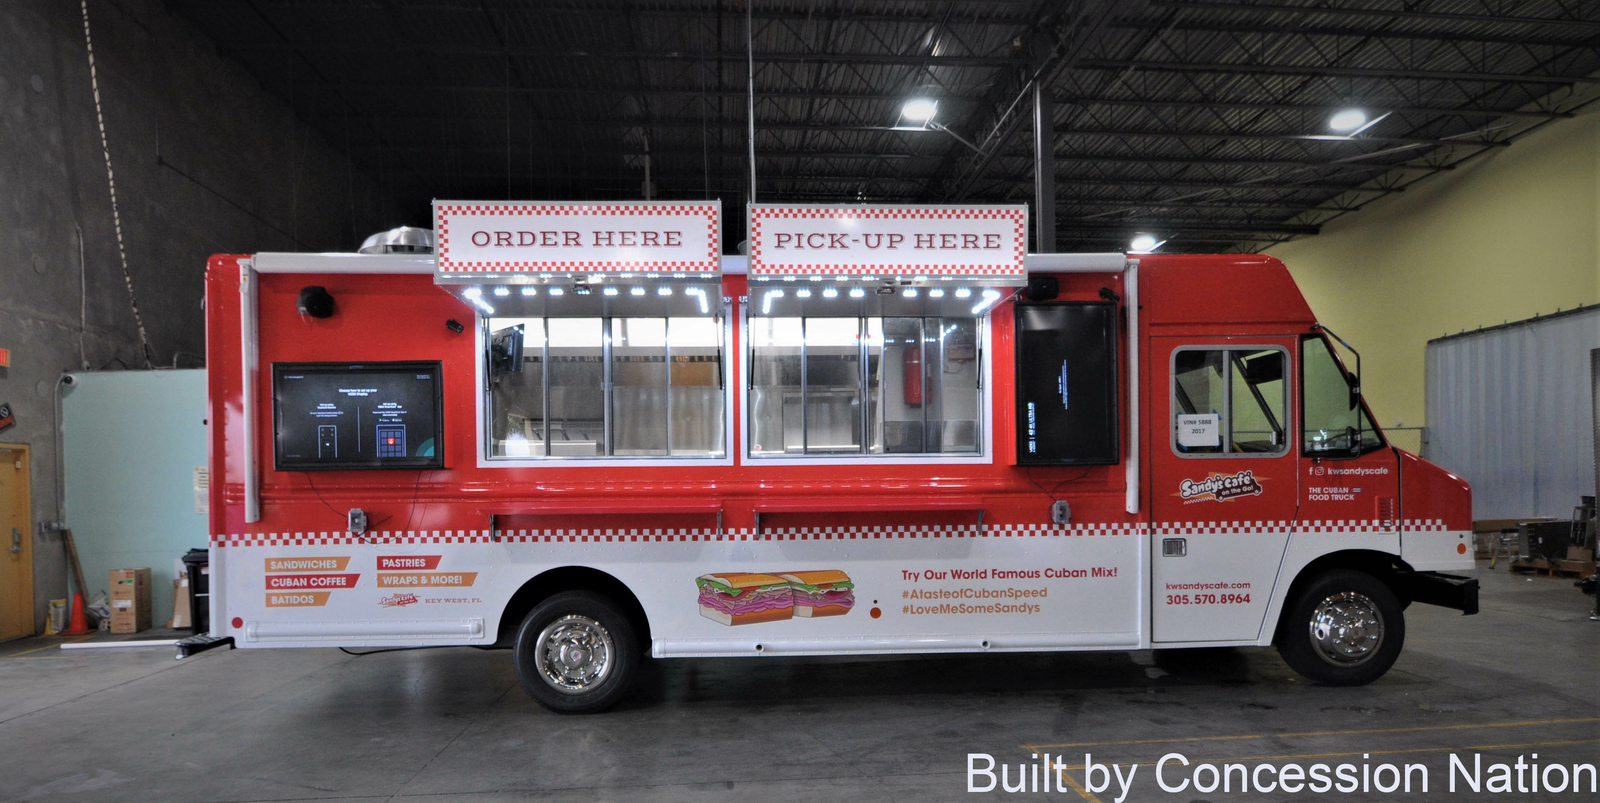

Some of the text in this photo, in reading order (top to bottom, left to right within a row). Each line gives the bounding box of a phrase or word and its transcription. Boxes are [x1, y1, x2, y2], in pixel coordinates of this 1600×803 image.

[471, 230, 683, 248] ORDER HERE
[774, 233, 1003, 250] PICK-UP HERE
[1327, 466, 1389, 476] kwsandyscafe
[1181, 475, 1223, 497] Sandy's
[270, 559, 337, 570] SANDWICHES
[382, 558, 426, 568] PASTRIES
[382, 575, 463, 585] WRAPS & MORE!
[902, 566, 1118, 583] Try Our World Famous Cuban Mix!
[270, 576, 347, 588] CUBAN COFFEE
[1166, 582, 1251, 592] kwsandyscafe.com
[270, 594, 315, 605] BATIDOS
[902, 586, 1048, 601] #AtasteofCubanSpeed
[1166, 593, 1251, 605] 305.570.8964
[902, 602, 1041, 616] #LoveMeSomeSandys
